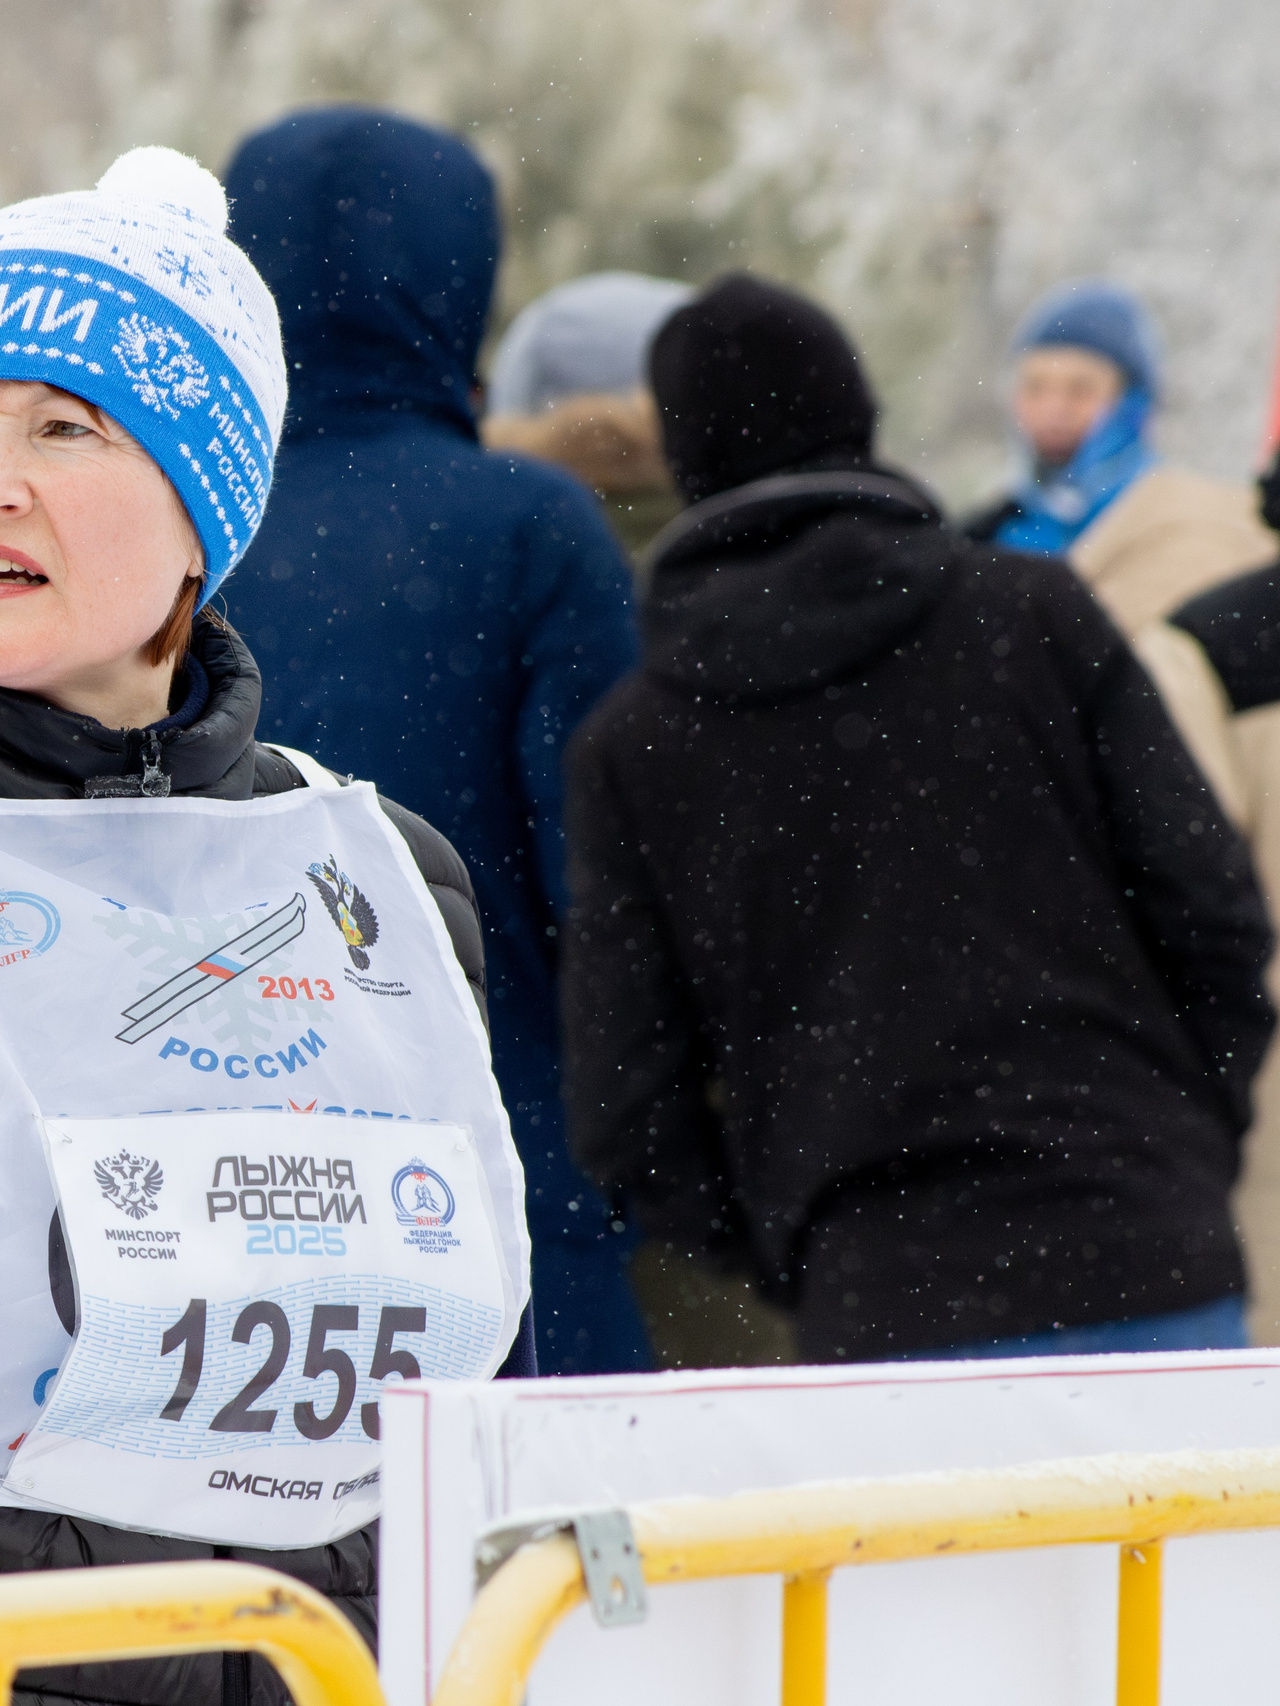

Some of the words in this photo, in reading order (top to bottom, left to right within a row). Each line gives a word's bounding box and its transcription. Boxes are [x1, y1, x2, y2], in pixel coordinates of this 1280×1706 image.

[208, 402, 267, 508] МИНСПО
[257, 975, 335, 1002] 2013
[371, 988, 411, 997] ФЕДЕРАЦИИ
[158, 1027, 327, 1079] РОССИИ
[212, 1155, 356, 1191] ЛЫЖНЯ
[206, 1189, 368, 1225] РОССИИ
[409, 1230, 453, 1239] ФЕДЕРАЦИЯ
[415, 1216, 440, 1227] ФЛГР
[104, 1228, 181, 1244] МИНСПОРТ
[246, 1224, 347, 1257] 2025
[403, 1237, 437, 1247] ЛЫЖНЫХ
[438, 1239, 462, 1248] ГОНОК
[118, 1246, 178, 1261] РОССИИ
[419, 1245, 449, 1255] РОССИИ
[158, 1298, 427, 1441] 1255
[208, 1469, 324, 1501] ОМСКАЯ
